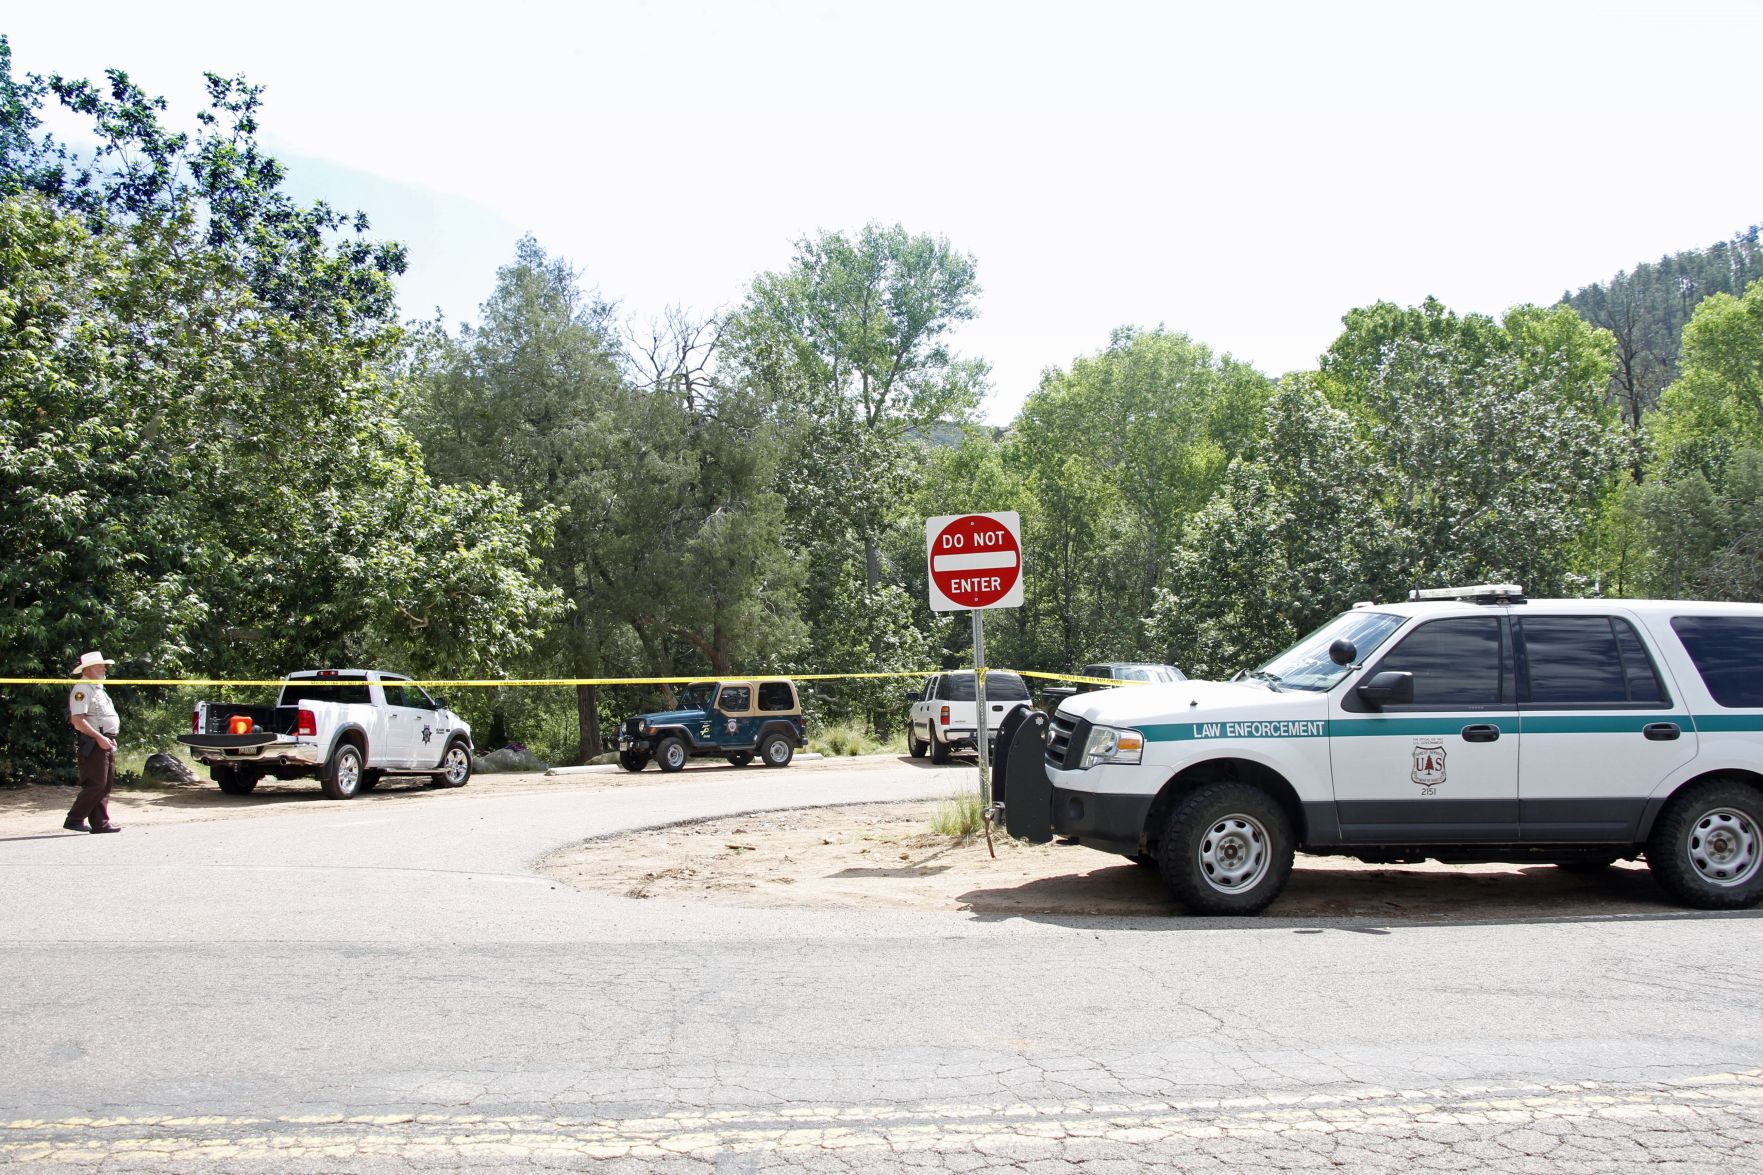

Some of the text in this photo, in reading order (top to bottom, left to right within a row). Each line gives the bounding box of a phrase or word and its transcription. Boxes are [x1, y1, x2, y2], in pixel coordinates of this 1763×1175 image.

[943, 531, 1005, 548] DO NOT
[951, 577, 1001, 593] ENTER
[1193, 721, 1325, 738] LAW ENFORCEMENT
[1421, 788, 1437, 796] 2151
